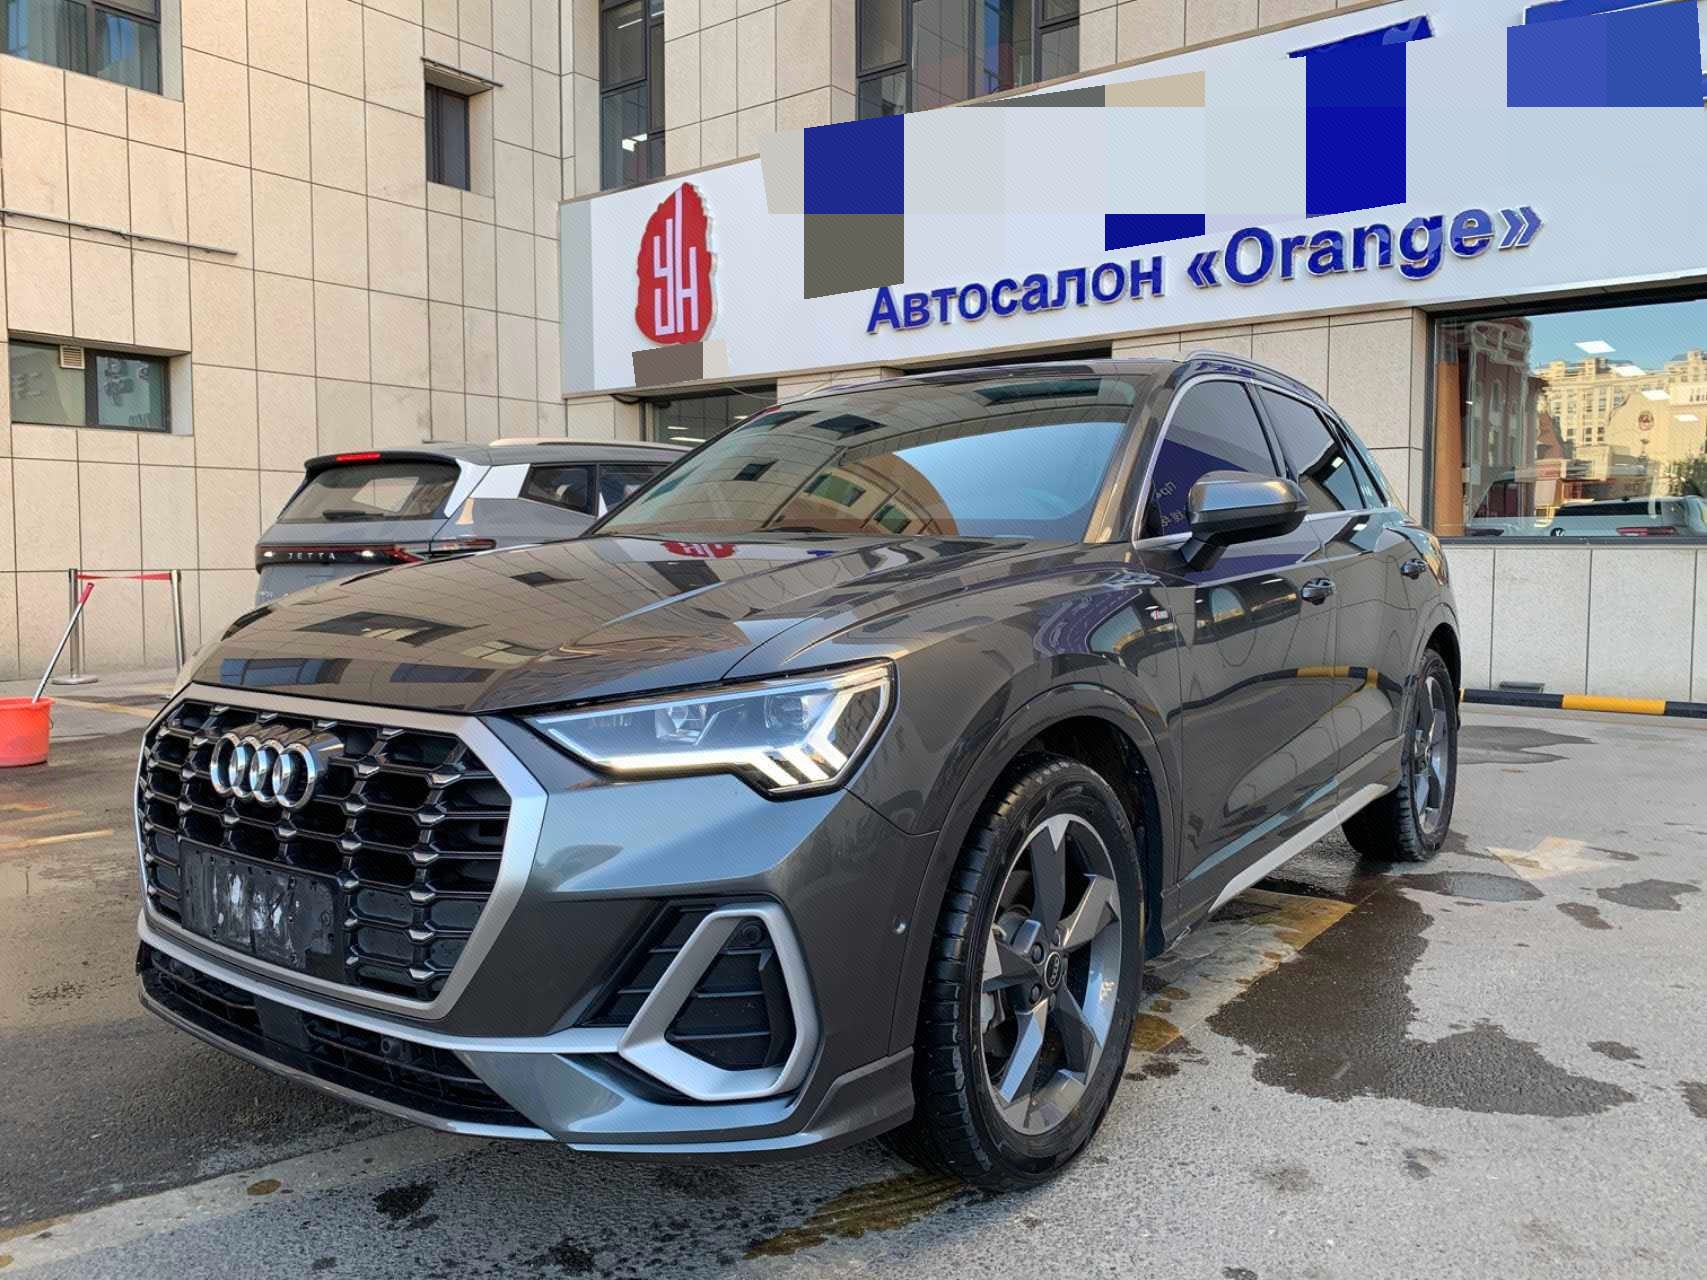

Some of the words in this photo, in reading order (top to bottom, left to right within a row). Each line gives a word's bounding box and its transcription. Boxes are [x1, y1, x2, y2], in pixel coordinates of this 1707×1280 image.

[867, 256, 1162, 334] Автосалон
[1187, 205, 1545, 281] «Orange»
[288, 552, 336, 560] JETTA
